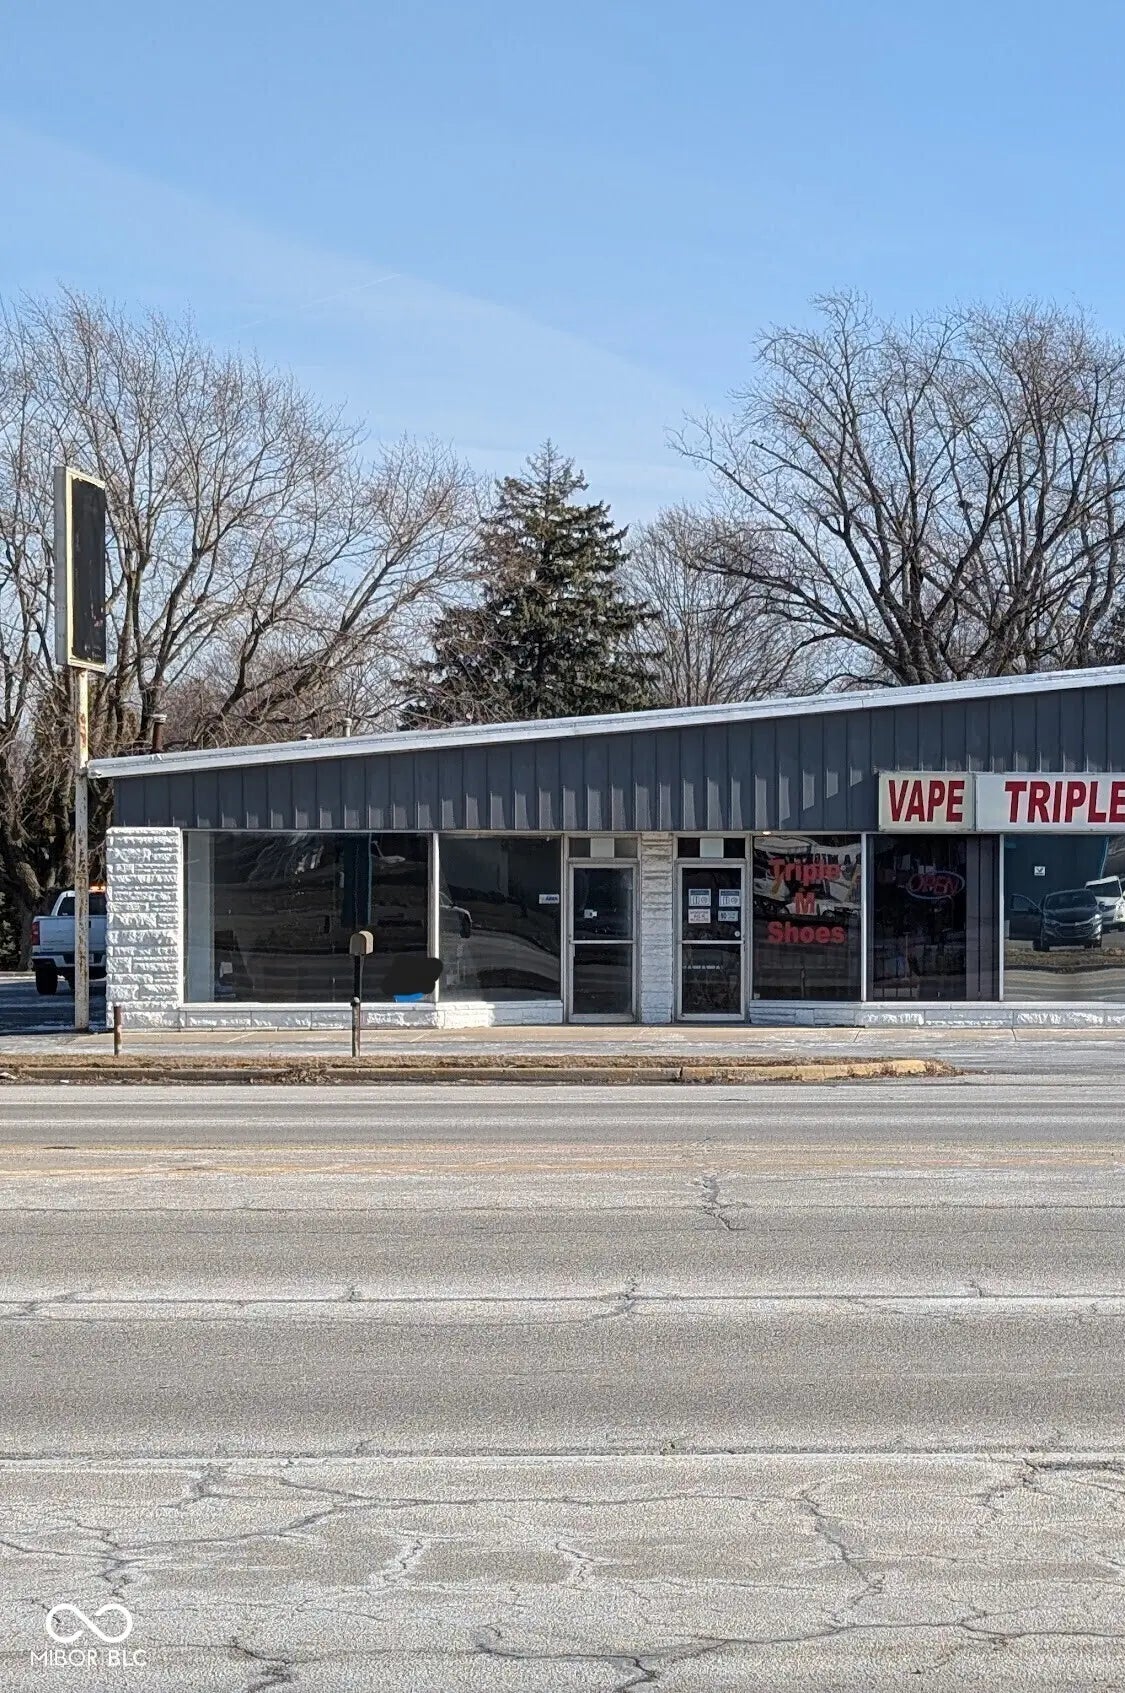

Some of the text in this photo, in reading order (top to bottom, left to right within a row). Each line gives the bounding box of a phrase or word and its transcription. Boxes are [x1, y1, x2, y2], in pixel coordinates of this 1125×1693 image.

[888, 779, 966, 823] VAPE
[768, 857, 841, 887] Triple
[795, 892, 815, 914] M
[767, 920, 845, 943] Shoes
